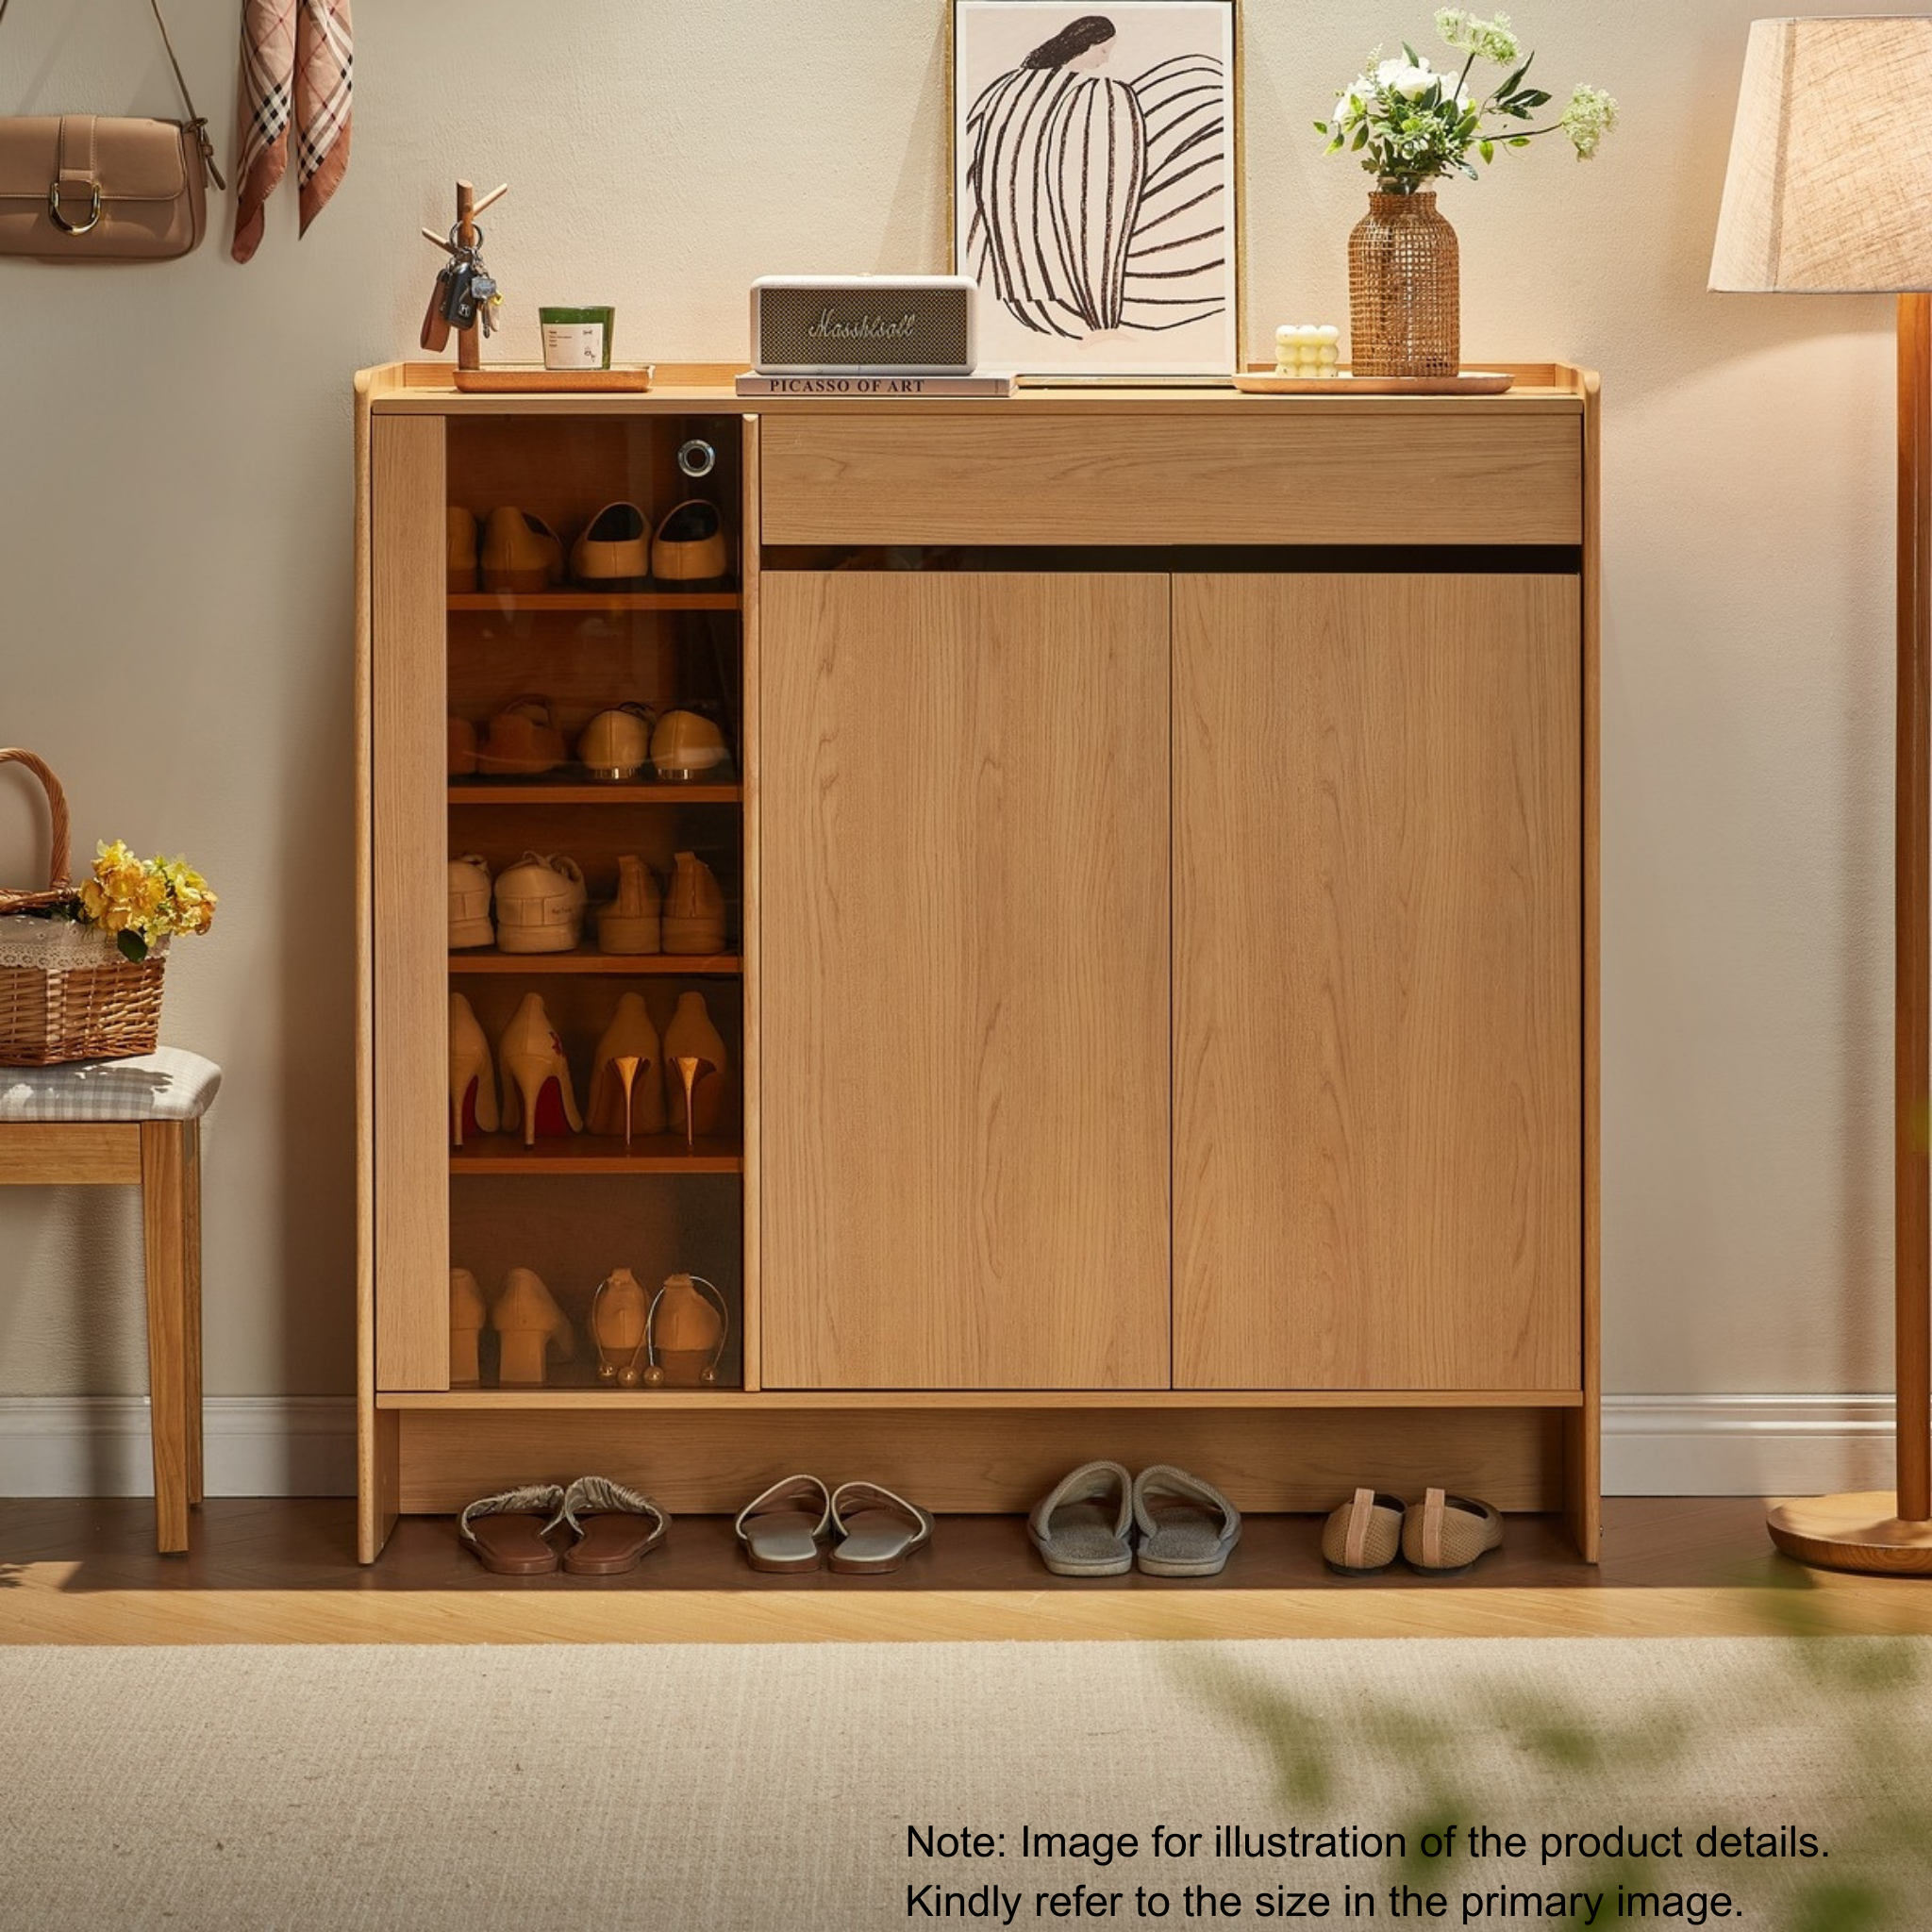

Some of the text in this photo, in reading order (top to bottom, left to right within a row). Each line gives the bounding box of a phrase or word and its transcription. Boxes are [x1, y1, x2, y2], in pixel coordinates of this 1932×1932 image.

[770, 379, 925, 392] PICASSO OF ART
